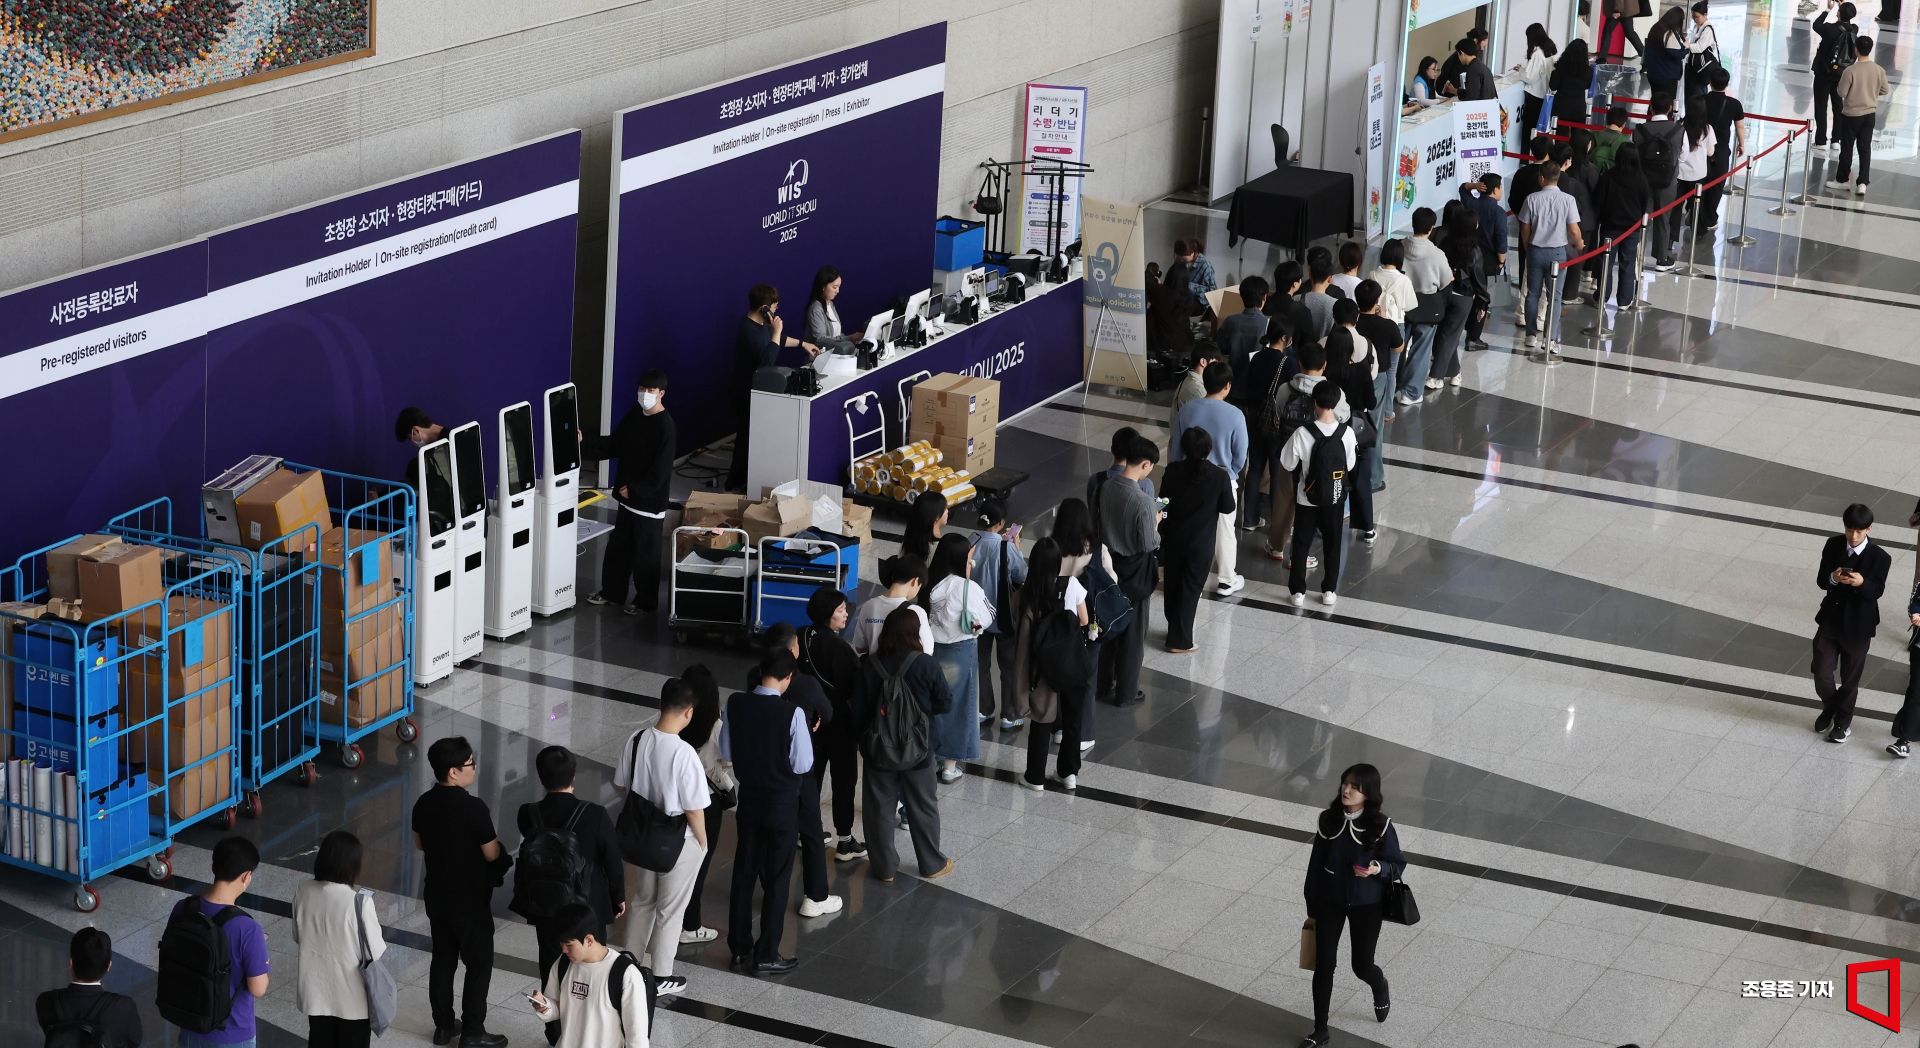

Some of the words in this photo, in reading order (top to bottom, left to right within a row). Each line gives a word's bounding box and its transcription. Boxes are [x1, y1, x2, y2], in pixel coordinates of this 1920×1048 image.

[719, 97, 743, 120] 초청장
[744, 90, 768, 112] 소지자
[772, 75, 817, 105] 현장티켓구매
[821, 70, 836, 89] 기자
[840, 59, 869, 84] 참가업체
[712, 137, 741, 155] Invitation
[741, 131, 761, 146] Holder
[766, 122, 787, 138] On-site
[788, 112, 820, 132] registration
[825, 106, 841, 119] Press
[846, 97, 871, 113] Exhibitor
[1426, 134, 1452, 164] 2025년
[324, 215, 356, 243] 초청장
[358, 206, 390, 233] 소지자
[396, 179, 483, 222] 현장티켓구매(카드)
[762, 209, 788, 229] WORLD
[796, 198, 817, 217] SHOW
[306, 266, 344, 288] Invitation
[344, 258, 372, 276] Holder
[380, 245, 410, 264] On-site
[478, 216, 498, 234] card)
[780, 226, 798, 244] 2025
[50, 280, 139, 326] 사전등록완료자
[40, 338, 111, 372] Pre-registered
[112, 330, 147, 349] visitors
[958, 356, 994, 380] OW
[994, 341, 1024, 375] 2025
